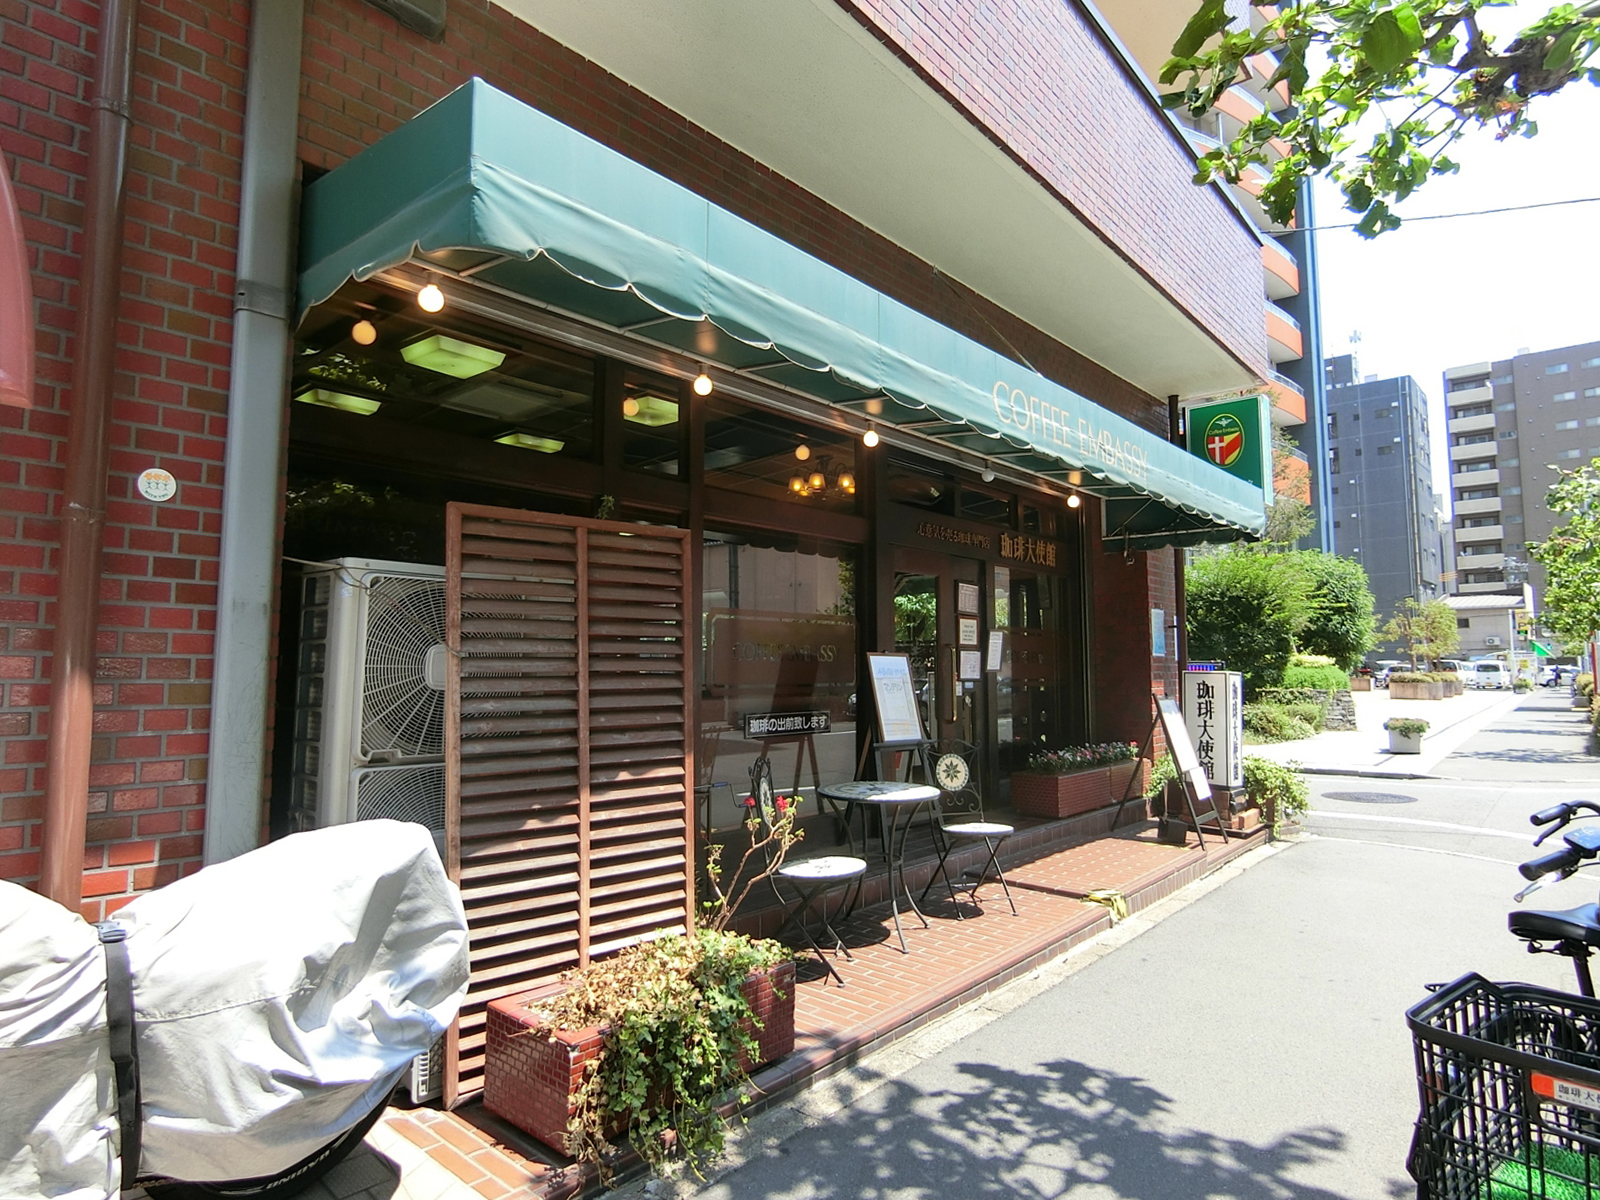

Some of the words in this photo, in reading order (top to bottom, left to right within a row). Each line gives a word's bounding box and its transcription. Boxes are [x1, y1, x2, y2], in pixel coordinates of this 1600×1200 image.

[992, 380, 1072, 449] COFFEE
[1077, 417, 1148, 481] EMBASSY
[1000, 532, 1057, 567] 珈琲大使館
[749, 715, 828, 733] 珈琲の出前致します
[1196, 680, 1214, 780] 珈琲大使館
[1558, 1083, 1600, 1104] 珈琲大
